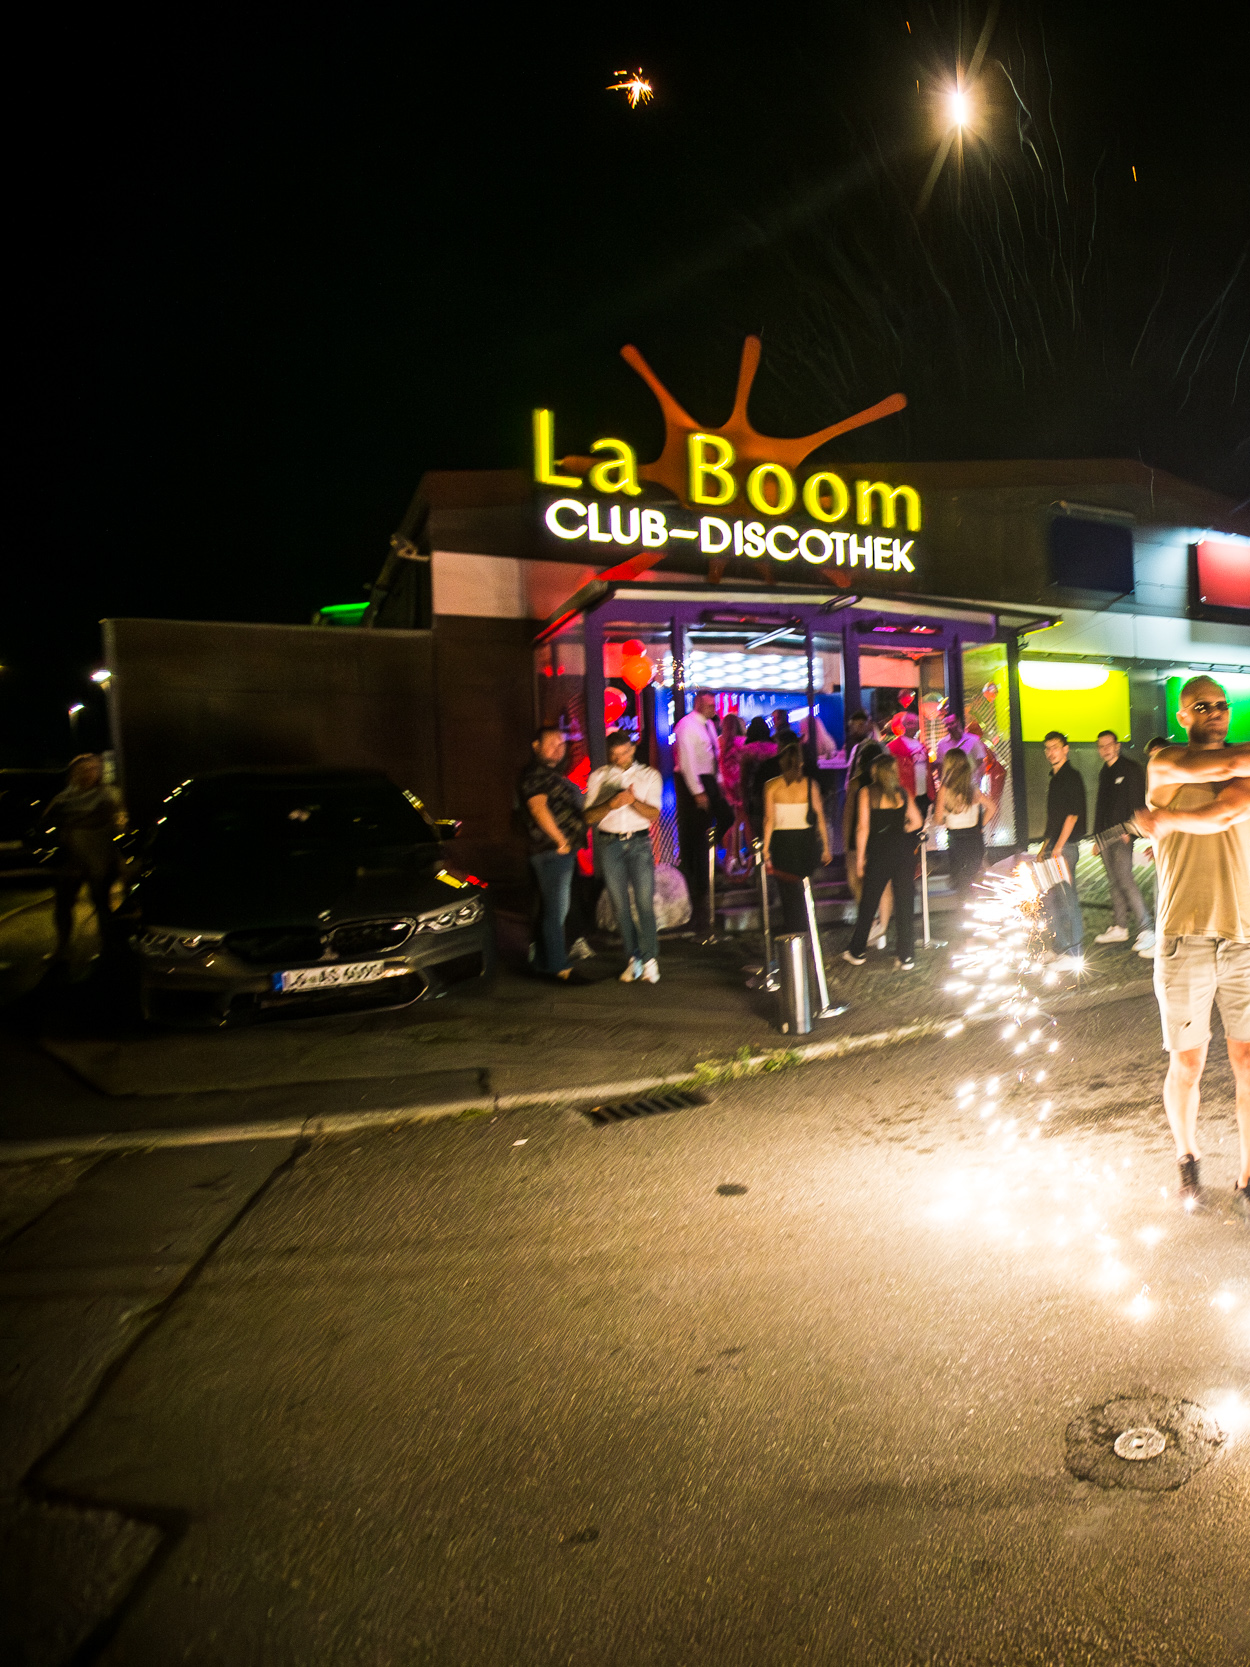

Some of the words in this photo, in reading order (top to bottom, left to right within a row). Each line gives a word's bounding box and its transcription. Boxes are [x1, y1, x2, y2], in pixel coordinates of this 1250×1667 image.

[532, 408, 642, 496] La
[688, 431, 922, 533] Boom
[545, 498, 916, 573] CLUB-DISCOTHEK
